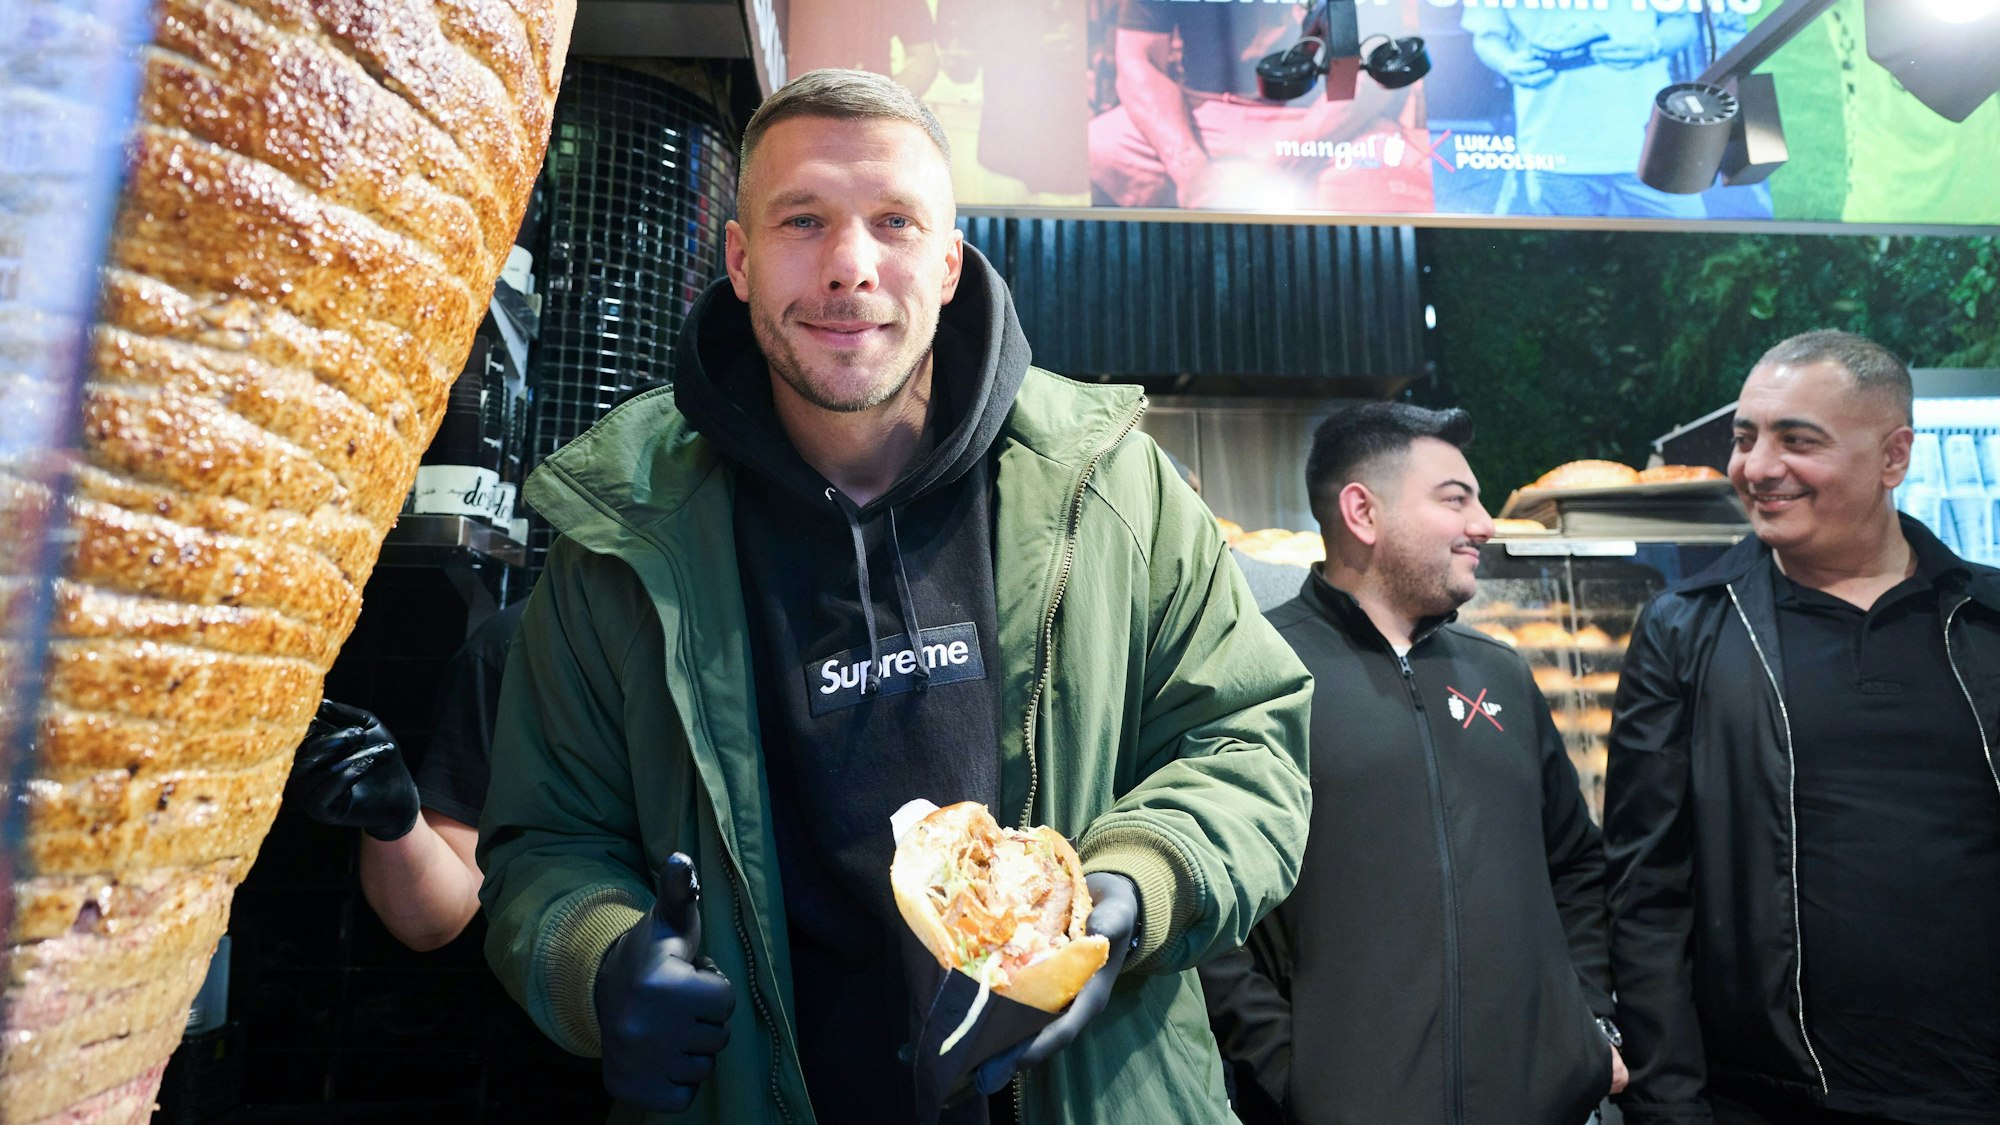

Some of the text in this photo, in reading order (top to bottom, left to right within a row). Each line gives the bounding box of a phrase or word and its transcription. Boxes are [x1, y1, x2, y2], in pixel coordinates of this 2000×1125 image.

[1275, 135, 1377, 170] mangal
[1454, 134, 1516, 152] LUKAS
[820, 640, 969, 695] Supreme
